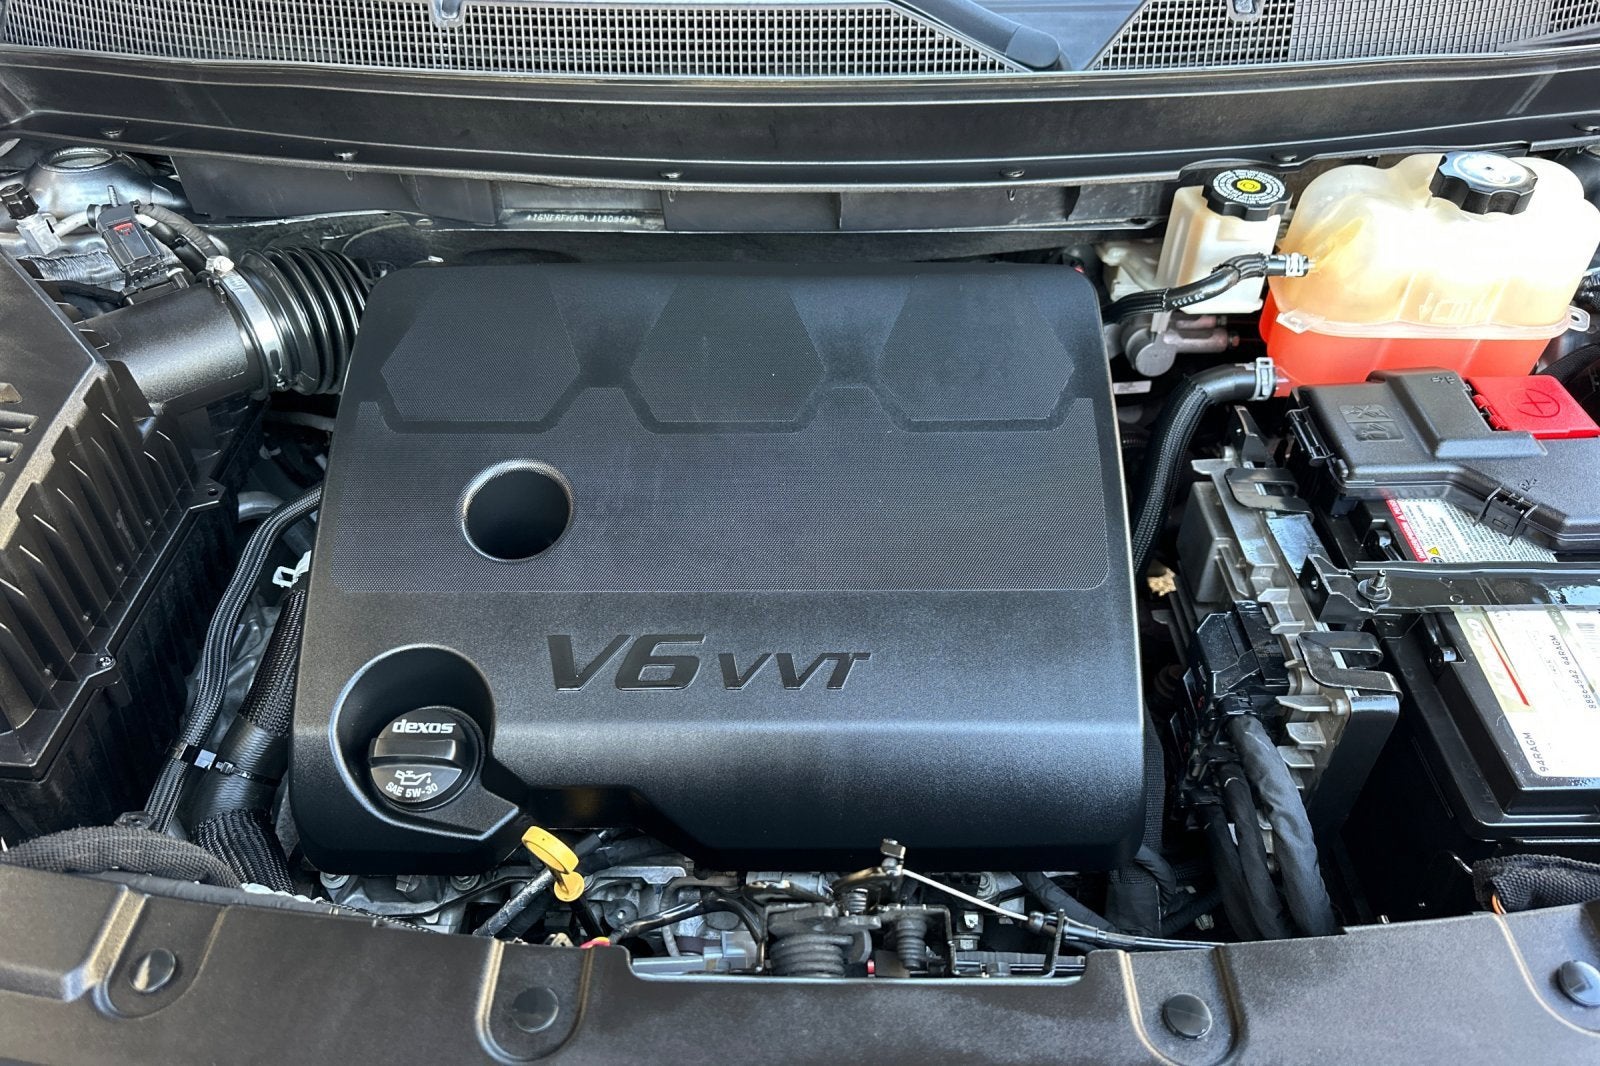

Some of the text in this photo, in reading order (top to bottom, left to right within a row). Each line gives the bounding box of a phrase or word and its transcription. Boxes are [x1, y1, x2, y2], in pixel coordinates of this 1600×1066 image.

[547, 634, 872, 691] V6 VVT
[392, 719, 456, 734] dexos
[1523, 732, 1548, 773] 94RAGM
[385, 781, 438, 798] SAE 5W-30
